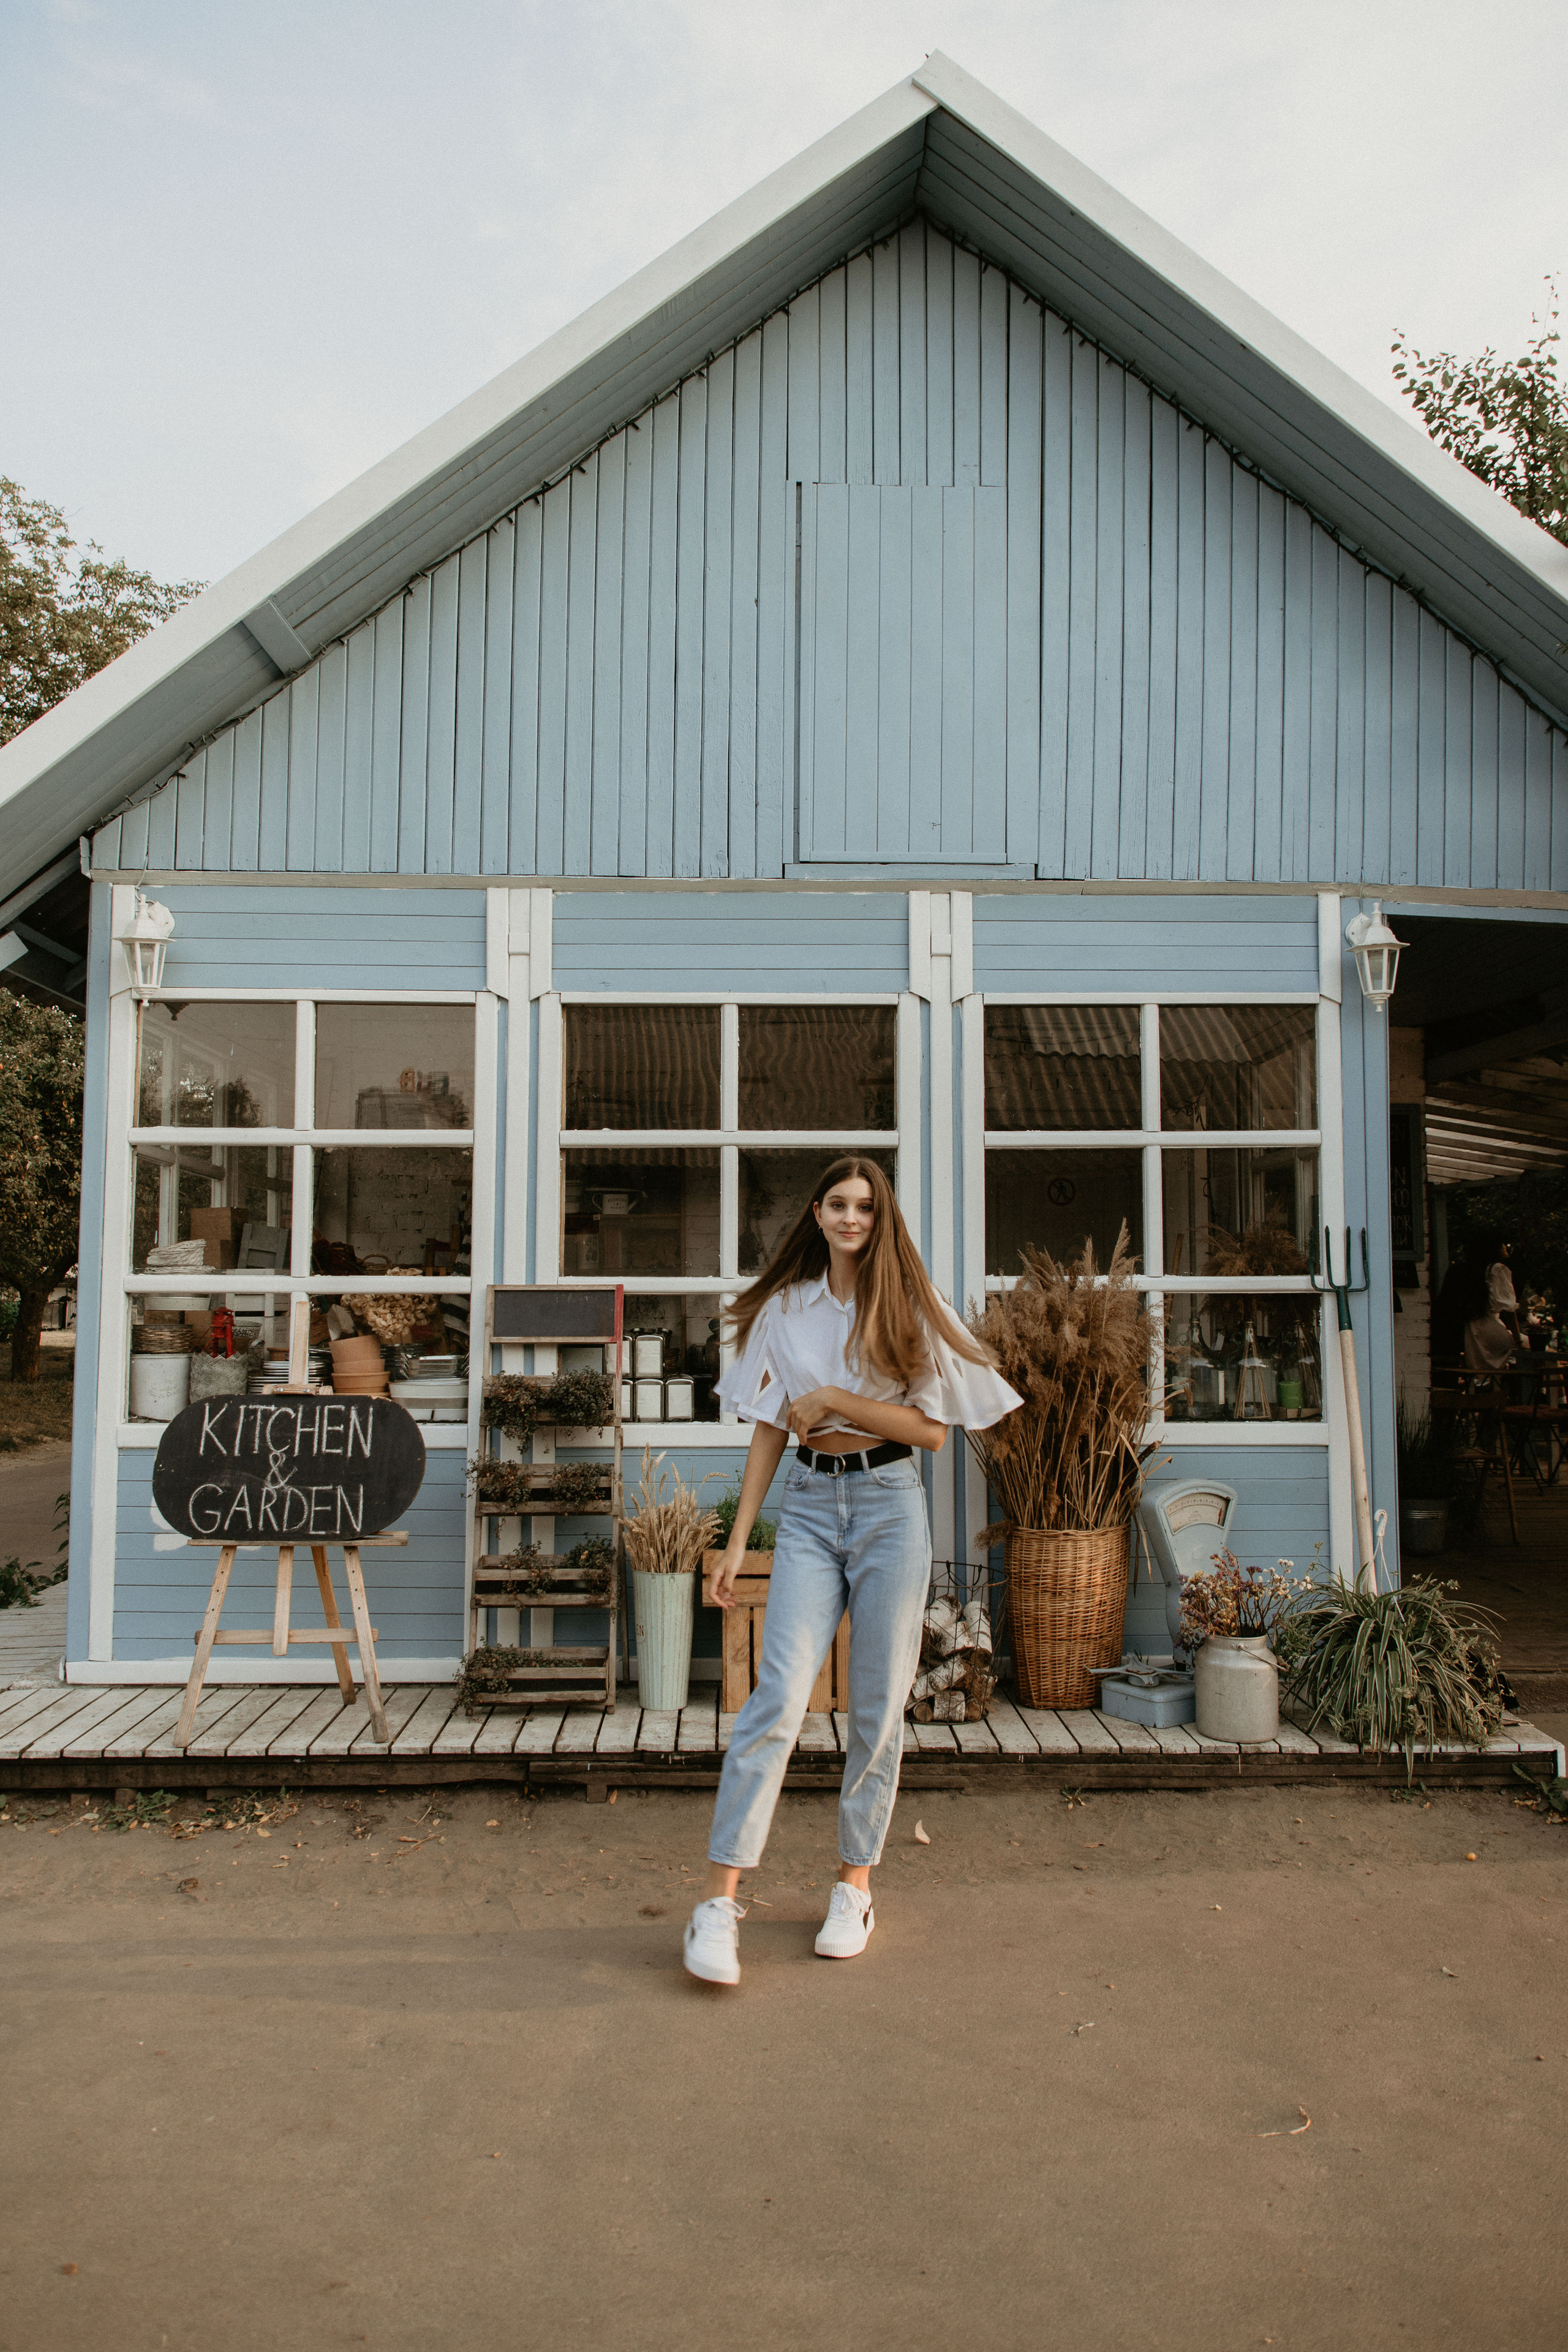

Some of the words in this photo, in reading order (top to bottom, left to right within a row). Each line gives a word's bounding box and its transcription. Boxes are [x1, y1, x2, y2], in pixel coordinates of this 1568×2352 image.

[200, 1403, 374, 1457] KITCHEN
[265, 1452, 298, 1489] &
[189, 1483, 364, 1534] GARDEN
